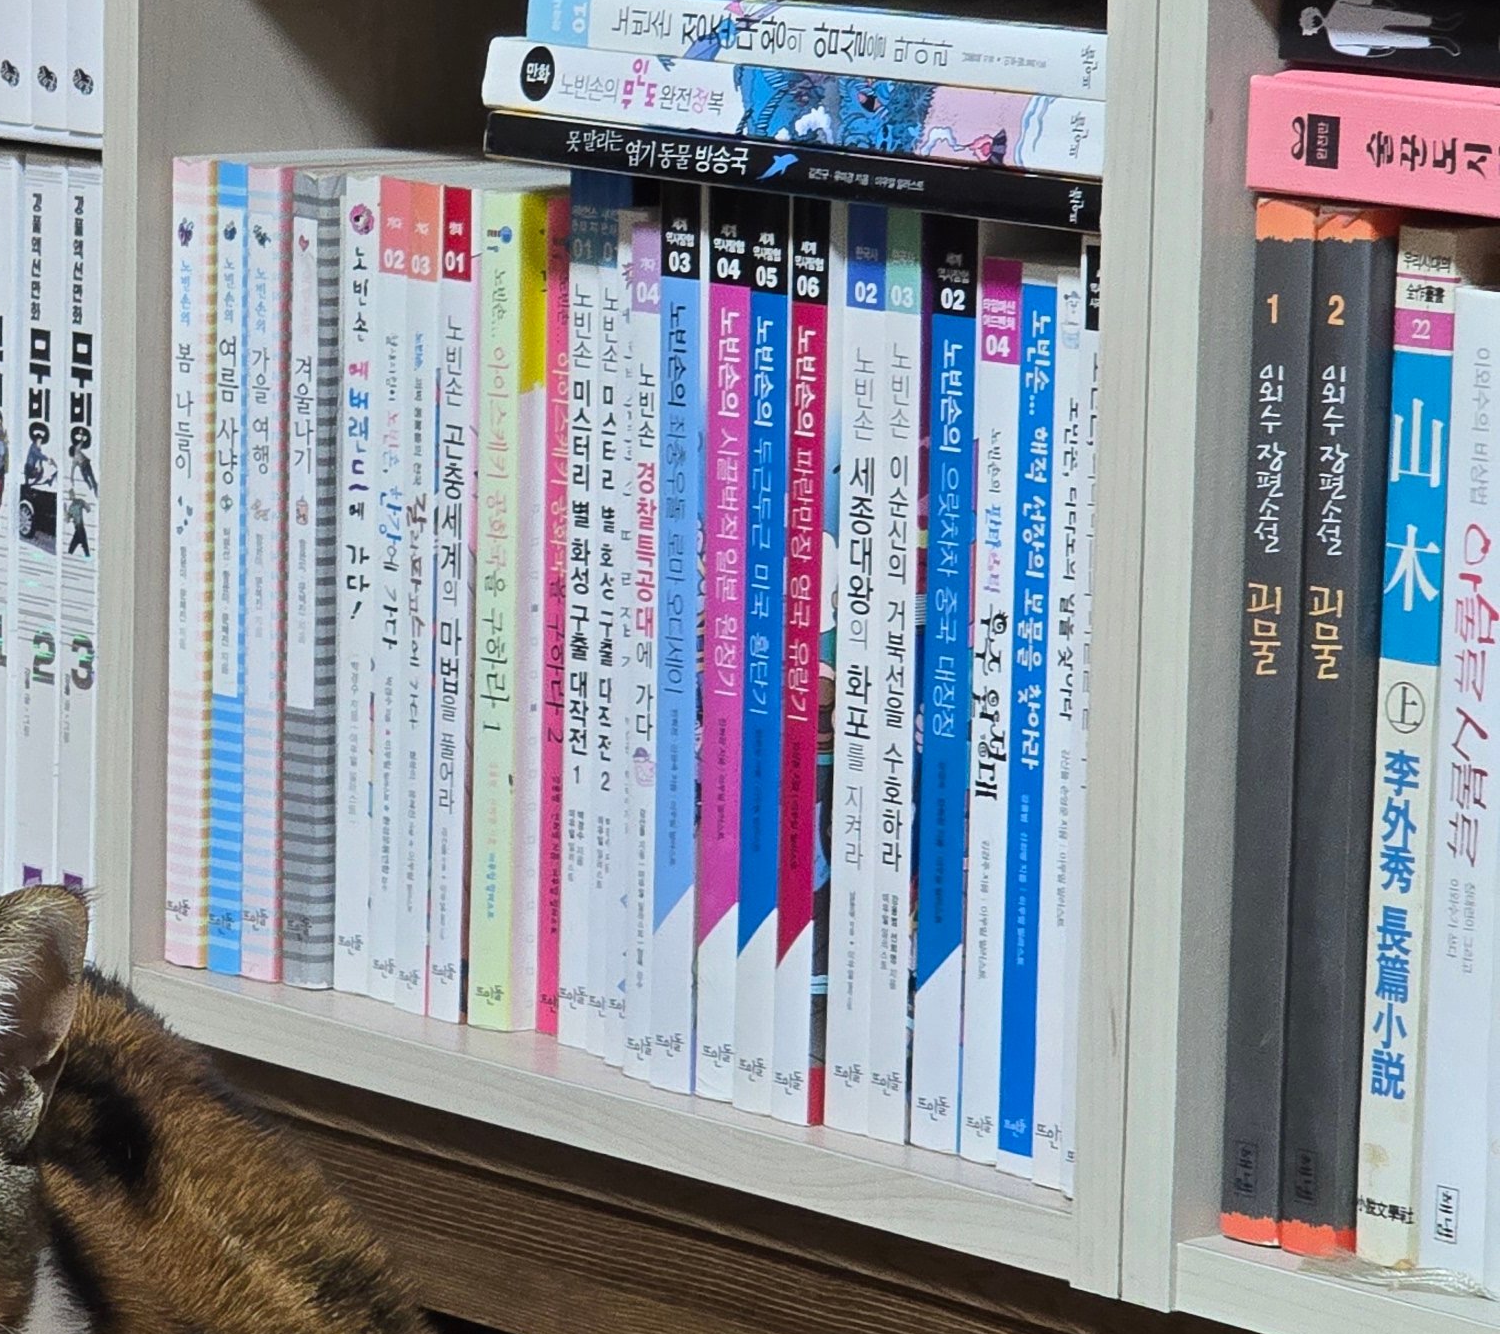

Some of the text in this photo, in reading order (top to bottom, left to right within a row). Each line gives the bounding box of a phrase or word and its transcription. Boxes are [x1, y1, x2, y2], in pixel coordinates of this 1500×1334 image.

[525, 62, 725, 116] 만화 노빈손의 완전정복
[612, 6, 954, 67] 노빈손 막아라
[695, 148, 749, 175] 방송국
[445, 252, 465, 272] 01
[669, 251, 691, 273] 03
[796, 274, 820, 298] 06
[1402, 251, 1451, 274] 우리시대의
[1411, 319, 1431, 340] 22
[175, 344, 195, 479] 봄 나들이
[217, 336, 238, 485] 여름 사냥
[252, 347, 270, 475] 가을 여행
[568, 379, 593, 756] 미스터리 별 화성 구출 대작전
[714, 307, 741, 697] 노빈손의 시끌벅적 일본 원정기
[1247, 364, 1284, 676] 이외수 괴물
[1308, 365, 1347, 681] 이외수 괴물
[1384, 397, 1444, 612] 山木
[750, 439, 772, 715] 두근두근 미국 횡단기
[787, 447, 814, 722] 파란만장 영국 유람기
[932, 463, 960, 739] 으랏차차 중국 대장정
[1016, 427, 1049, 771] 해적 선장의 보물을 찾아라
[636, 684, 653, 741] 가다
[844, 456, 875, 872] 세종대왕의 화포를 지켜라
[1380, 749, 1421, 895] 李外秀
